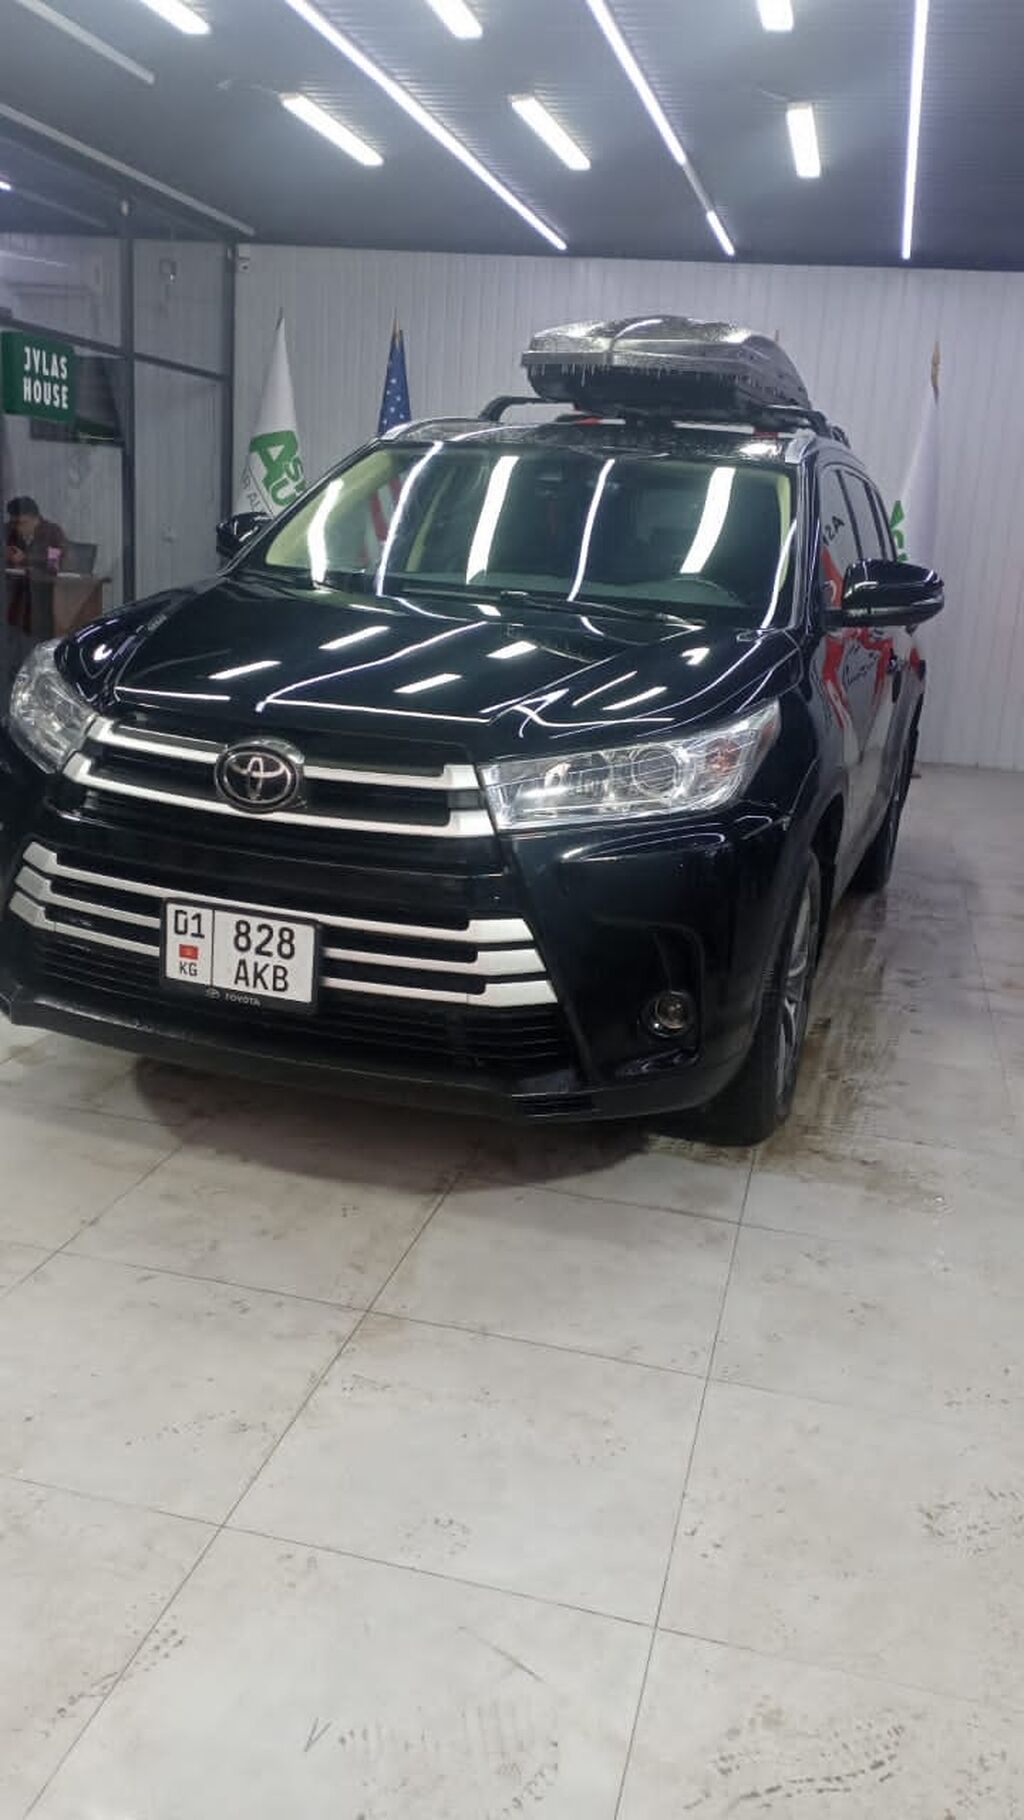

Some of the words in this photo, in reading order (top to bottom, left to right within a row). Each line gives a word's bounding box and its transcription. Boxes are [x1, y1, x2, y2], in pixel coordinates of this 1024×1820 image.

[23, 377, 69, 409] HOUSE
[174, 909, 205, 939] 01
[233, 919, 295, 960] 828
[179, 961, 198, 977] KG
[233, 958, 289, 992] AKB
[225, 993, 261, 1006] TOYOTA
